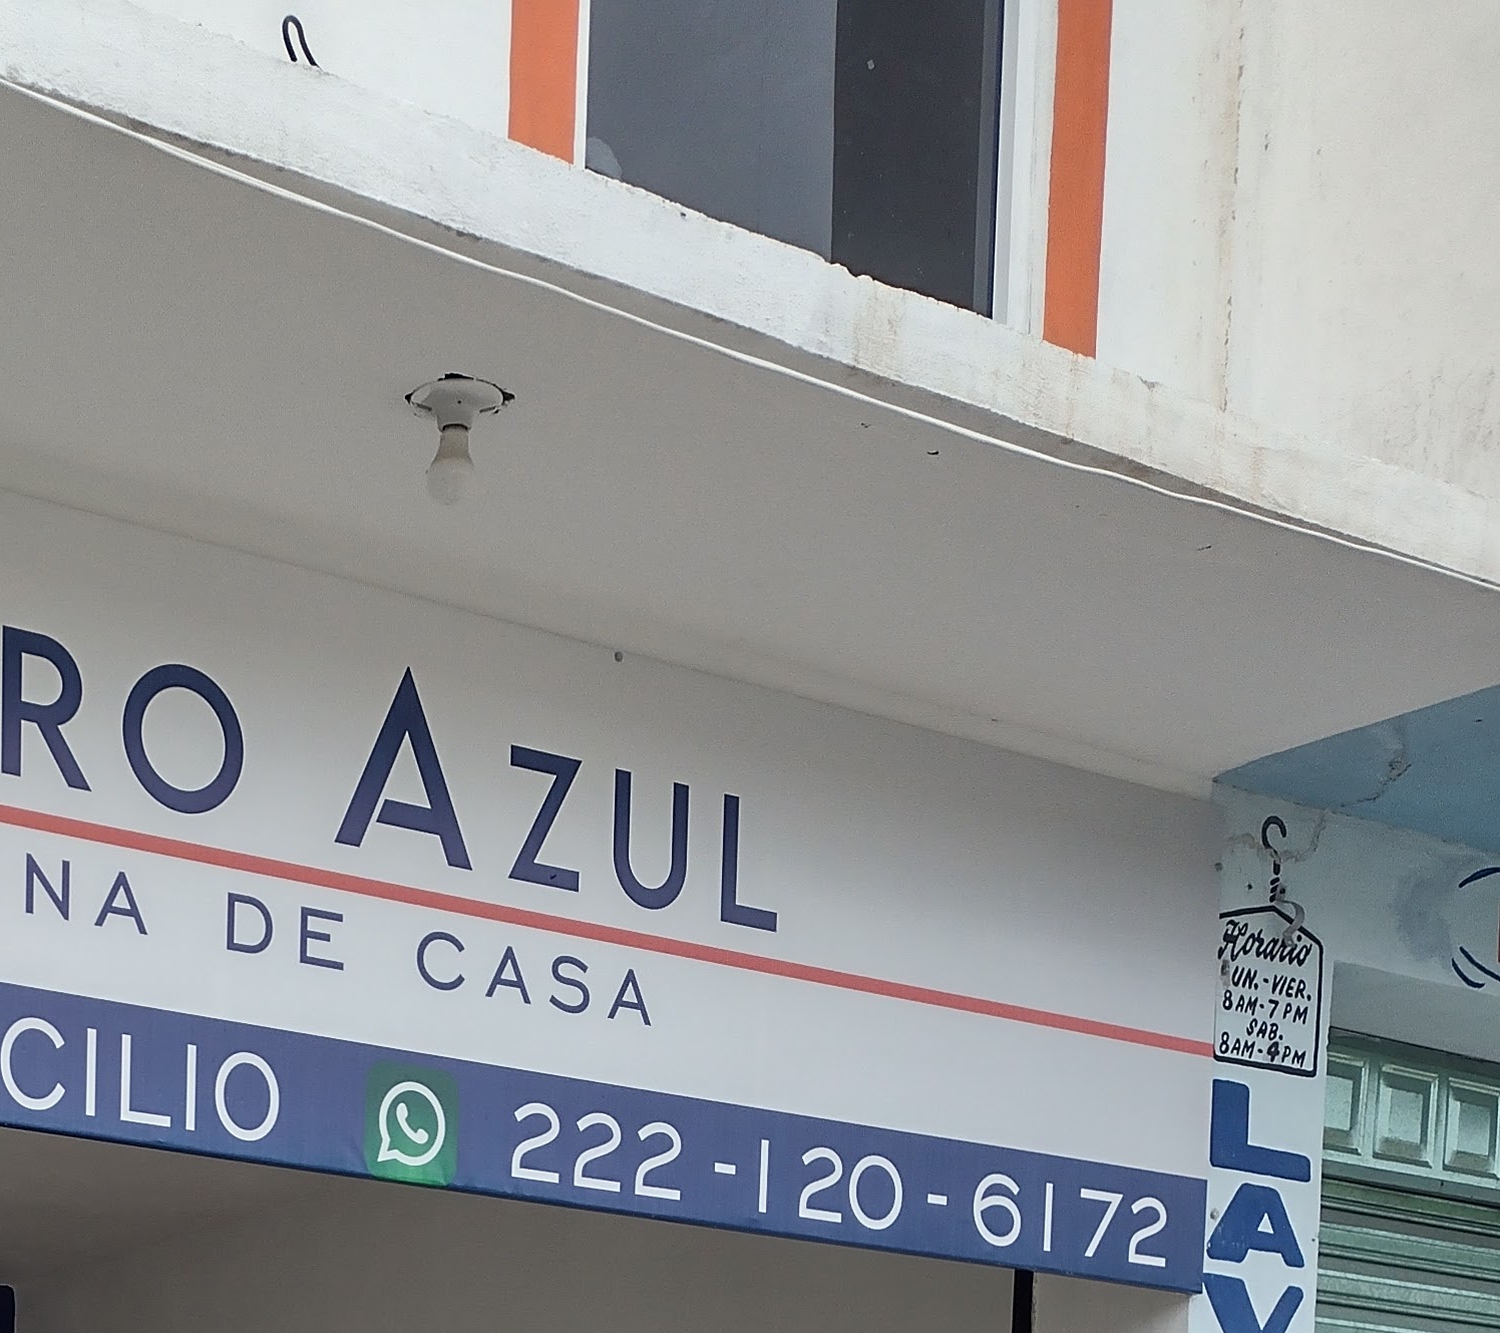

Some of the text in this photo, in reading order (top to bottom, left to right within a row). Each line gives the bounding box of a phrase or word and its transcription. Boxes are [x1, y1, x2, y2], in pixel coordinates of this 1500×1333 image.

[334, 666, 777, 932] AZUL
[226, 892, 344, 971] DE
[416, 931, 651, 1026] CASA
[1217, 919, 1312, 966] Horario
[1246, 1018, 1283, 1041] SAB.
